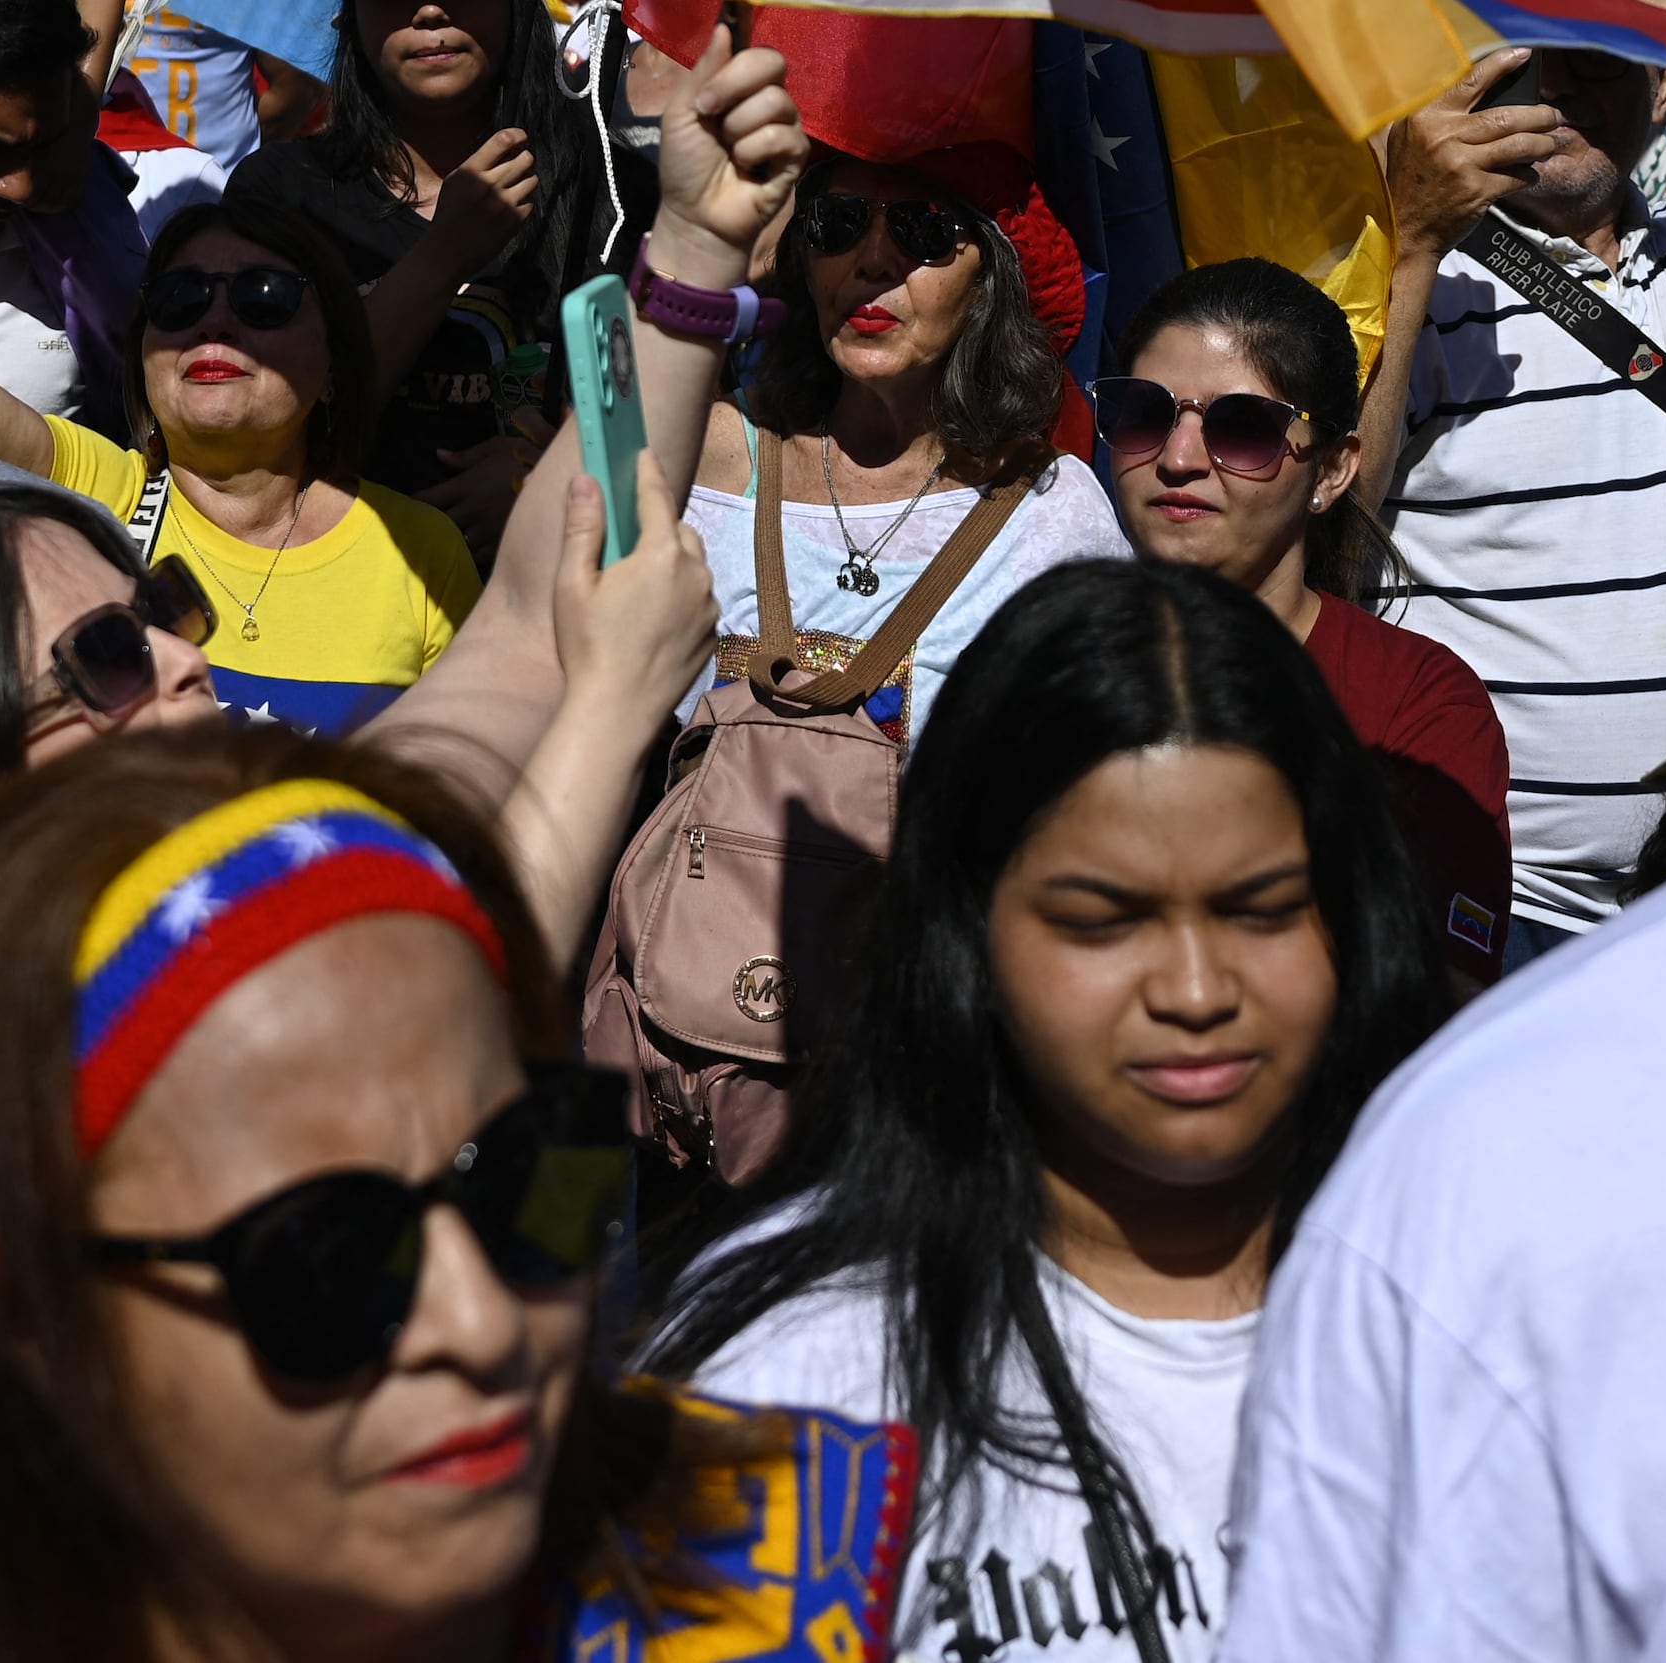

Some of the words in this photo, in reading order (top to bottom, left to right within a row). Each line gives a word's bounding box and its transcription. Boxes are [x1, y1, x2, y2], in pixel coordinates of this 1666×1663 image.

[1485, 250, 1532, 291] RIVER
[1531, 286, 1582, 329] PLATE
[1490, 230, 1531, 266] CLUB
[1533, 261, 1603, 321] ATLETICO
